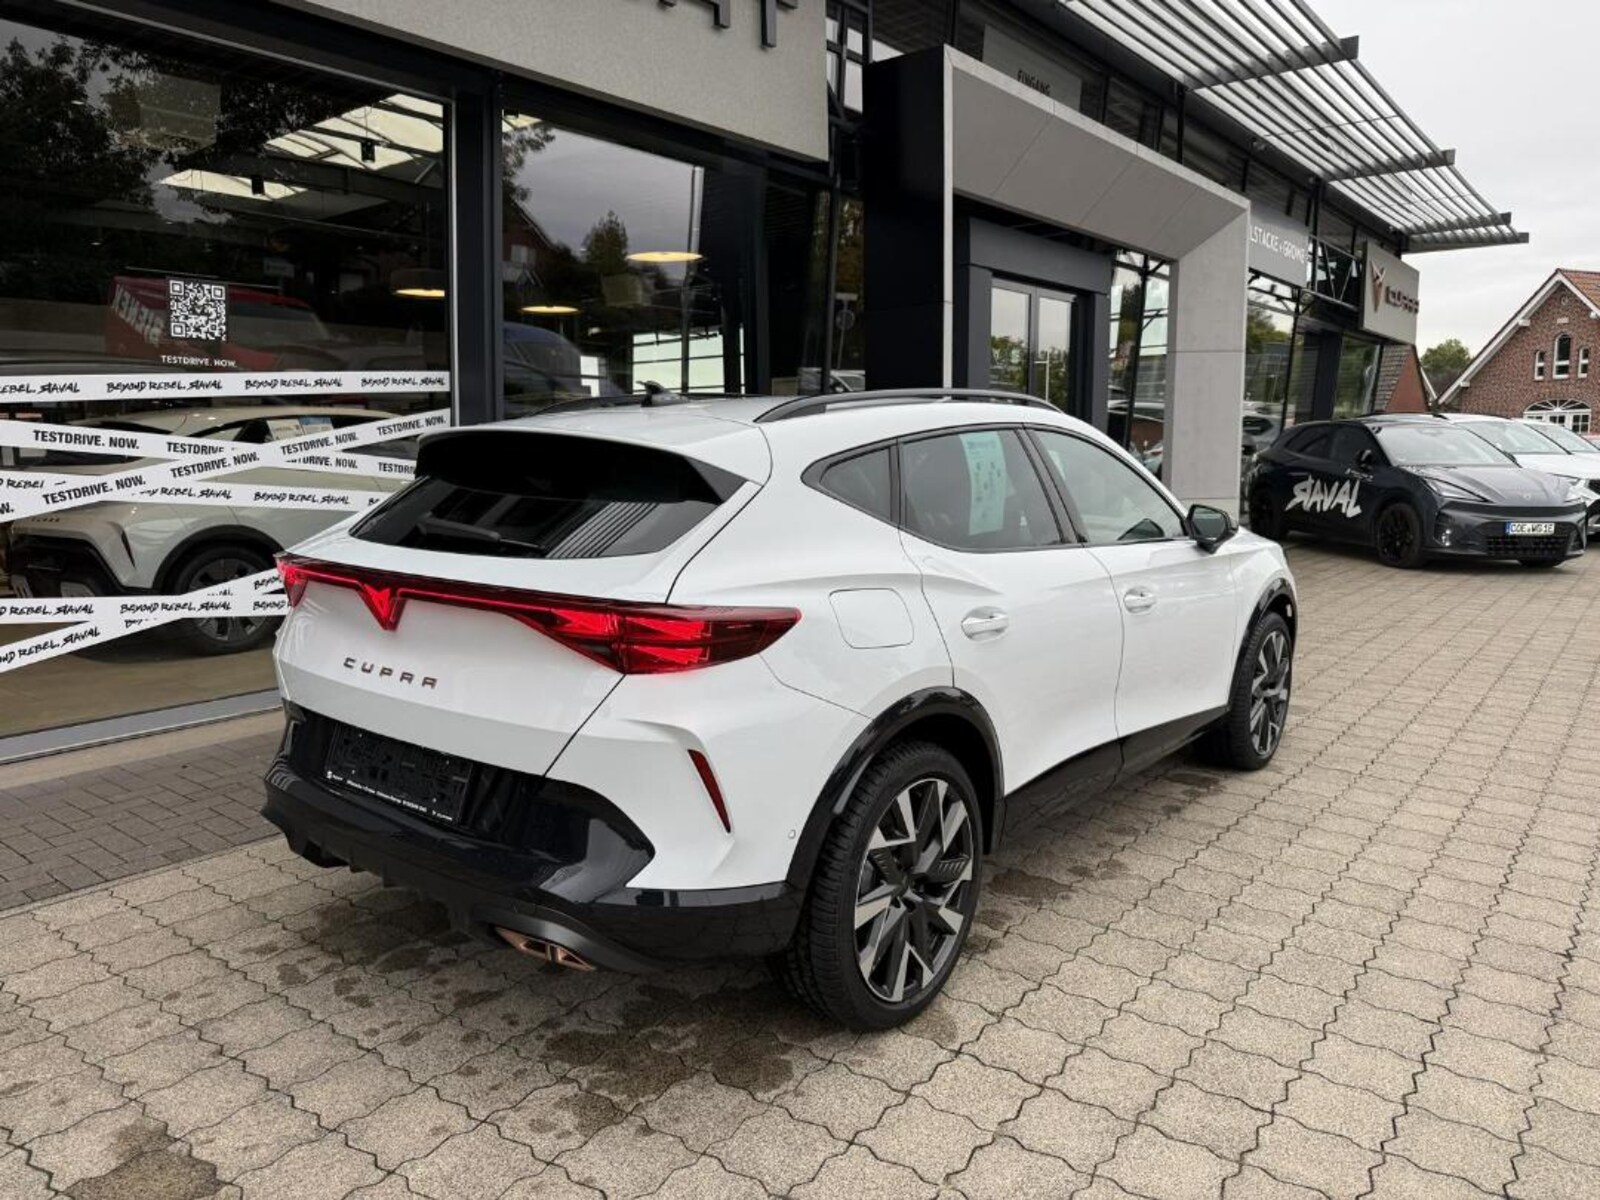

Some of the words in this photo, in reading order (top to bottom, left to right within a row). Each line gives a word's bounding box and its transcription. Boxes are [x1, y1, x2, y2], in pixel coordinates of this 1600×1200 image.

[33, 430, 106, 447] TESTDRIVE.
[109, 437, 140, 450] NOW.
[42, 482, 113, 504] TESTDRIVE.
[115, 475, 146, 490] NOW.
[170, 457, 231, 478] TESTDRIVE.
[233, 451, 260, 466] NOW.
[281, 437, 334, 455] TESTDRIVE.
[343, 657, 438, 689] CUPRA
